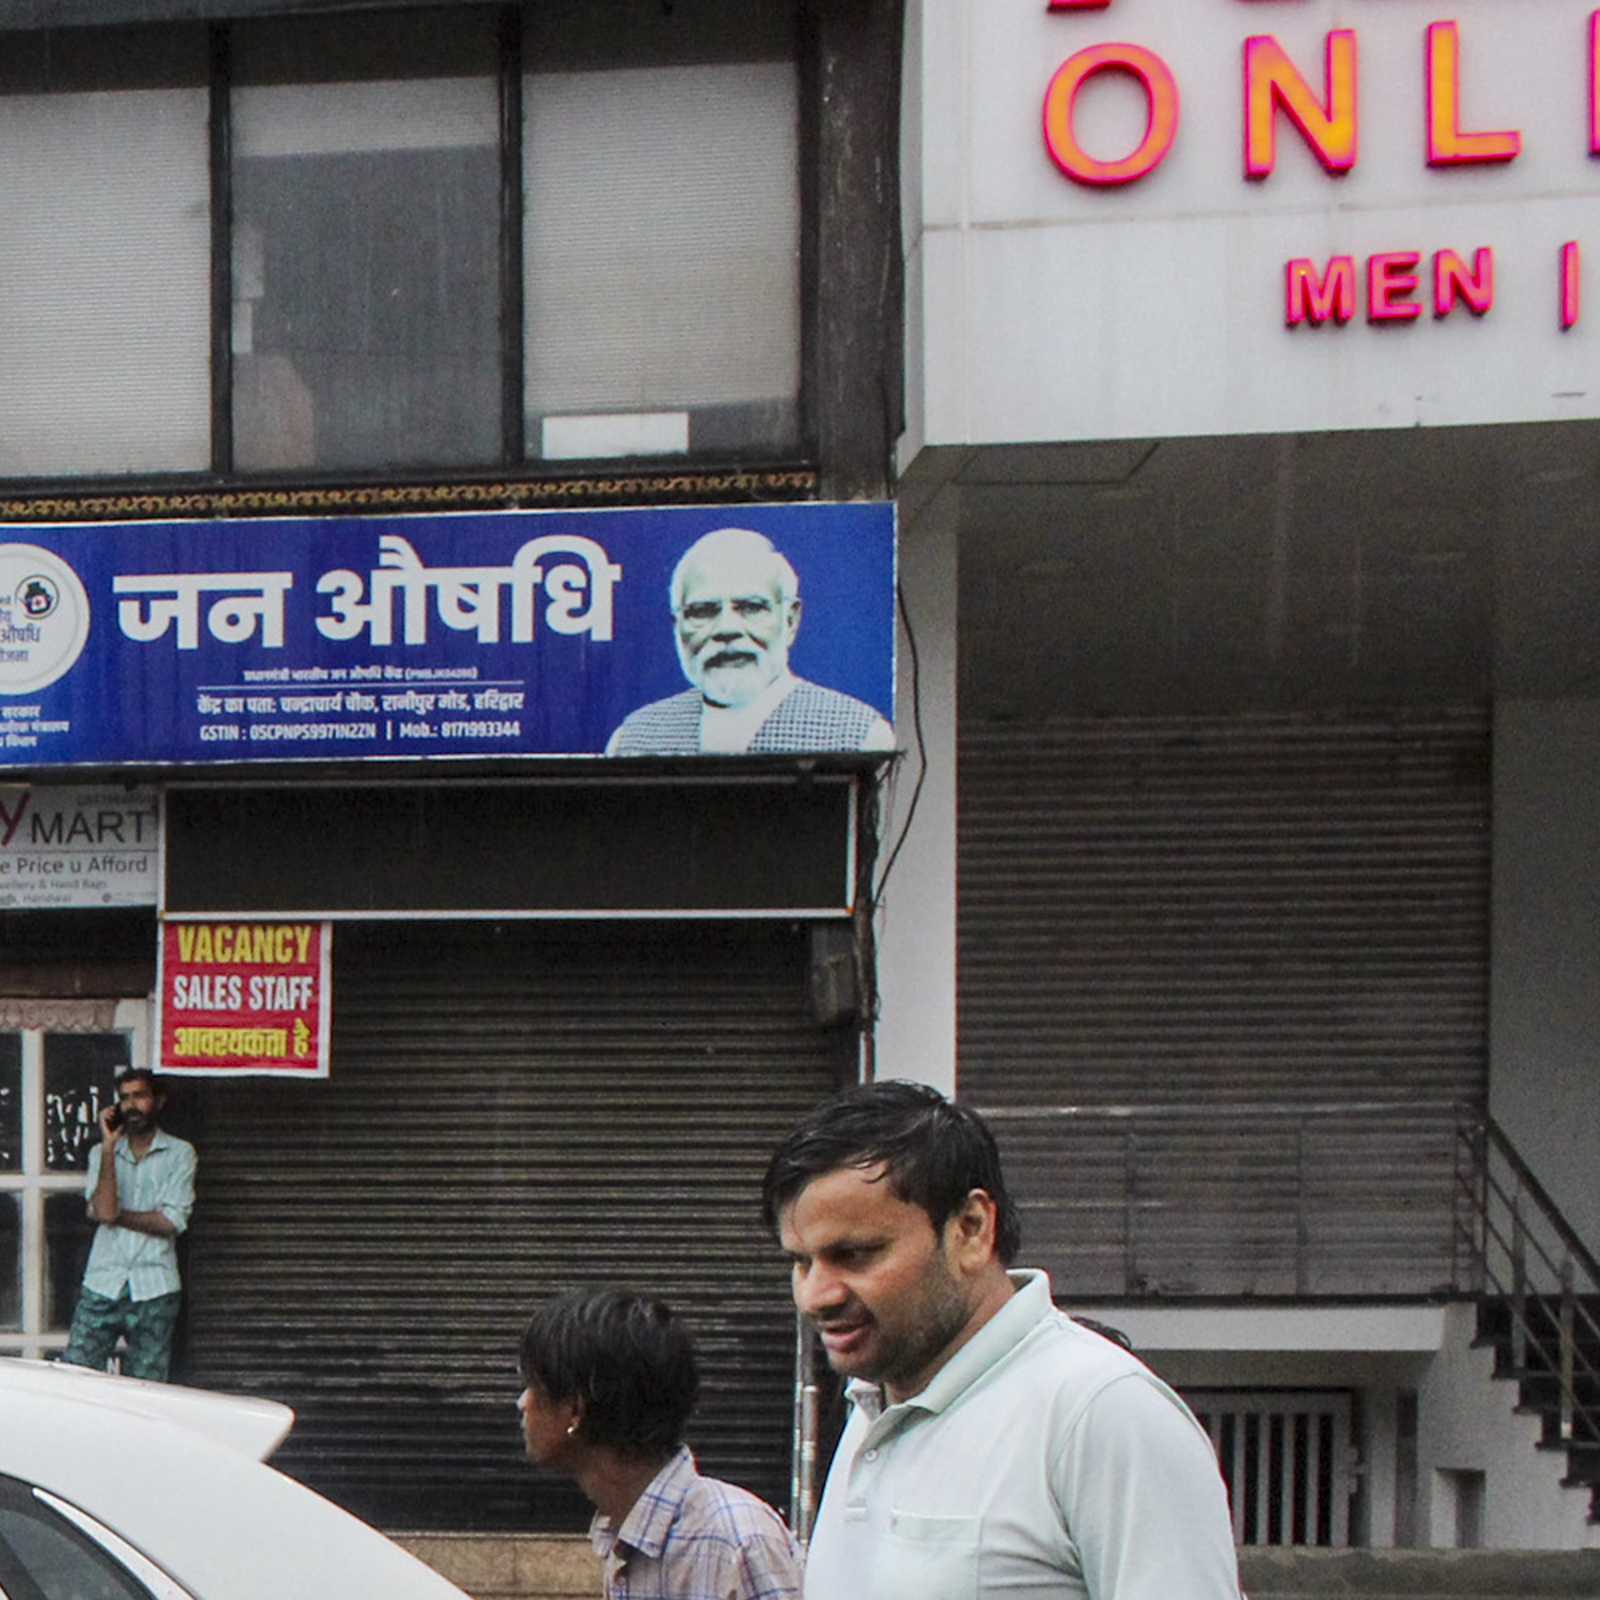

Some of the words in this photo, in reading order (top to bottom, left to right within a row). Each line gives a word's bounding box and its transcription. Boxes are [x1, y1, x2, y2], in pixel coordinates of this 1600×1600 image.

[1283, 245, 1494, 331] MEN
[112, 570, 294, 650] जन
[314, 535, 623, 646] औषधि
[199, 724, 240, 741] GSTIN
[30, 809, 150, 845] MART
[17, 856, 64, 875] Price
[70, 862, 82, 874] u
[87, 855, 149, 874] Afford
[176, 924, 313, 965] VACANCY
[172, 974, 244, 1011] SALES
[248, 975, 314, 1011] STAFF
[172, 1026, 288, 1058] आवश्यकता
[291, 1016, 312, 1059] है
